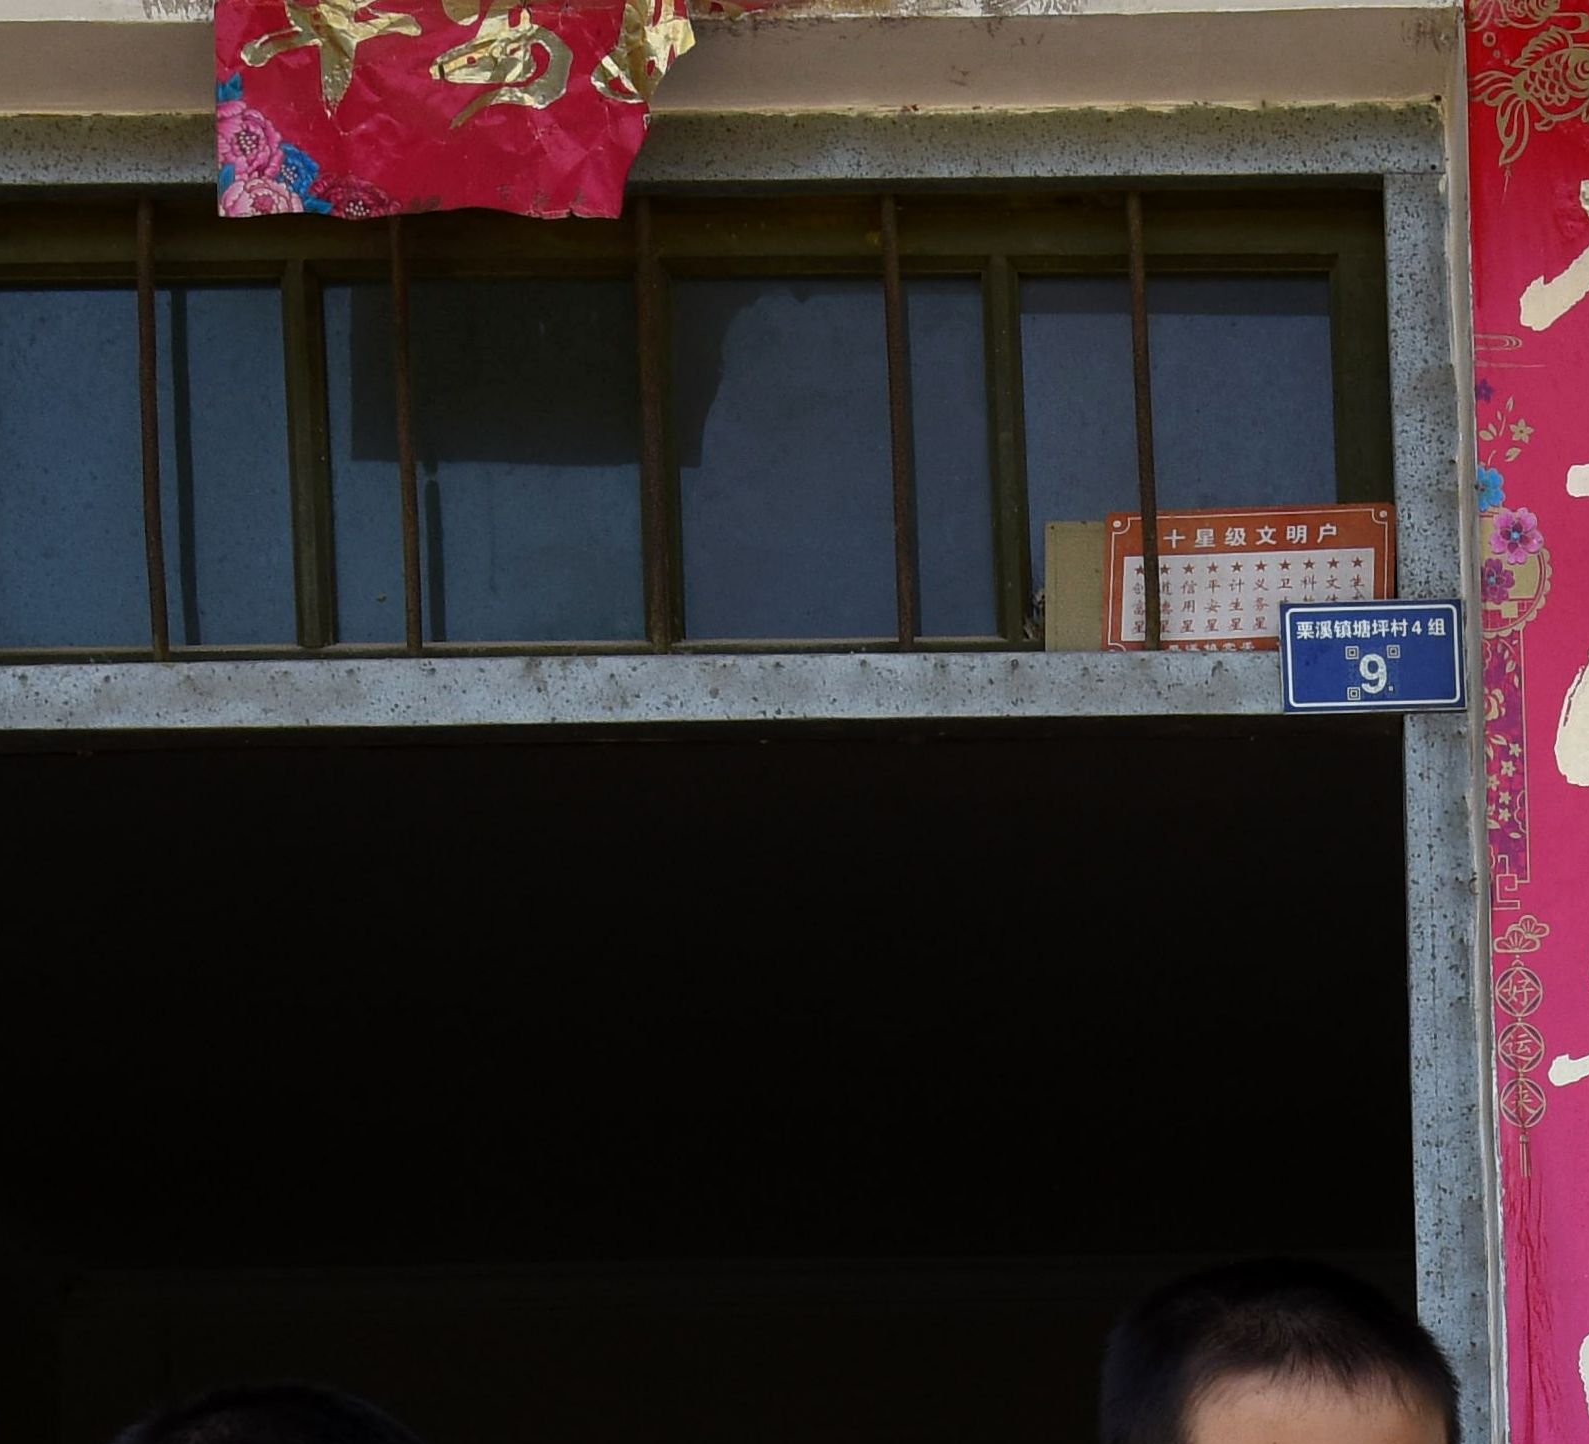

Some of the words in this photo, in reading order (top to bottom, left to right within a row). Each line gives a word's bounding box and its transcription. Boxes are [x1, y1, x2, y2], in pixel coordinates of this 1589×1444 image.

[1163, 523, 1339, 550] 十星级文明户
[1359, 653, 1388, 695] 9
